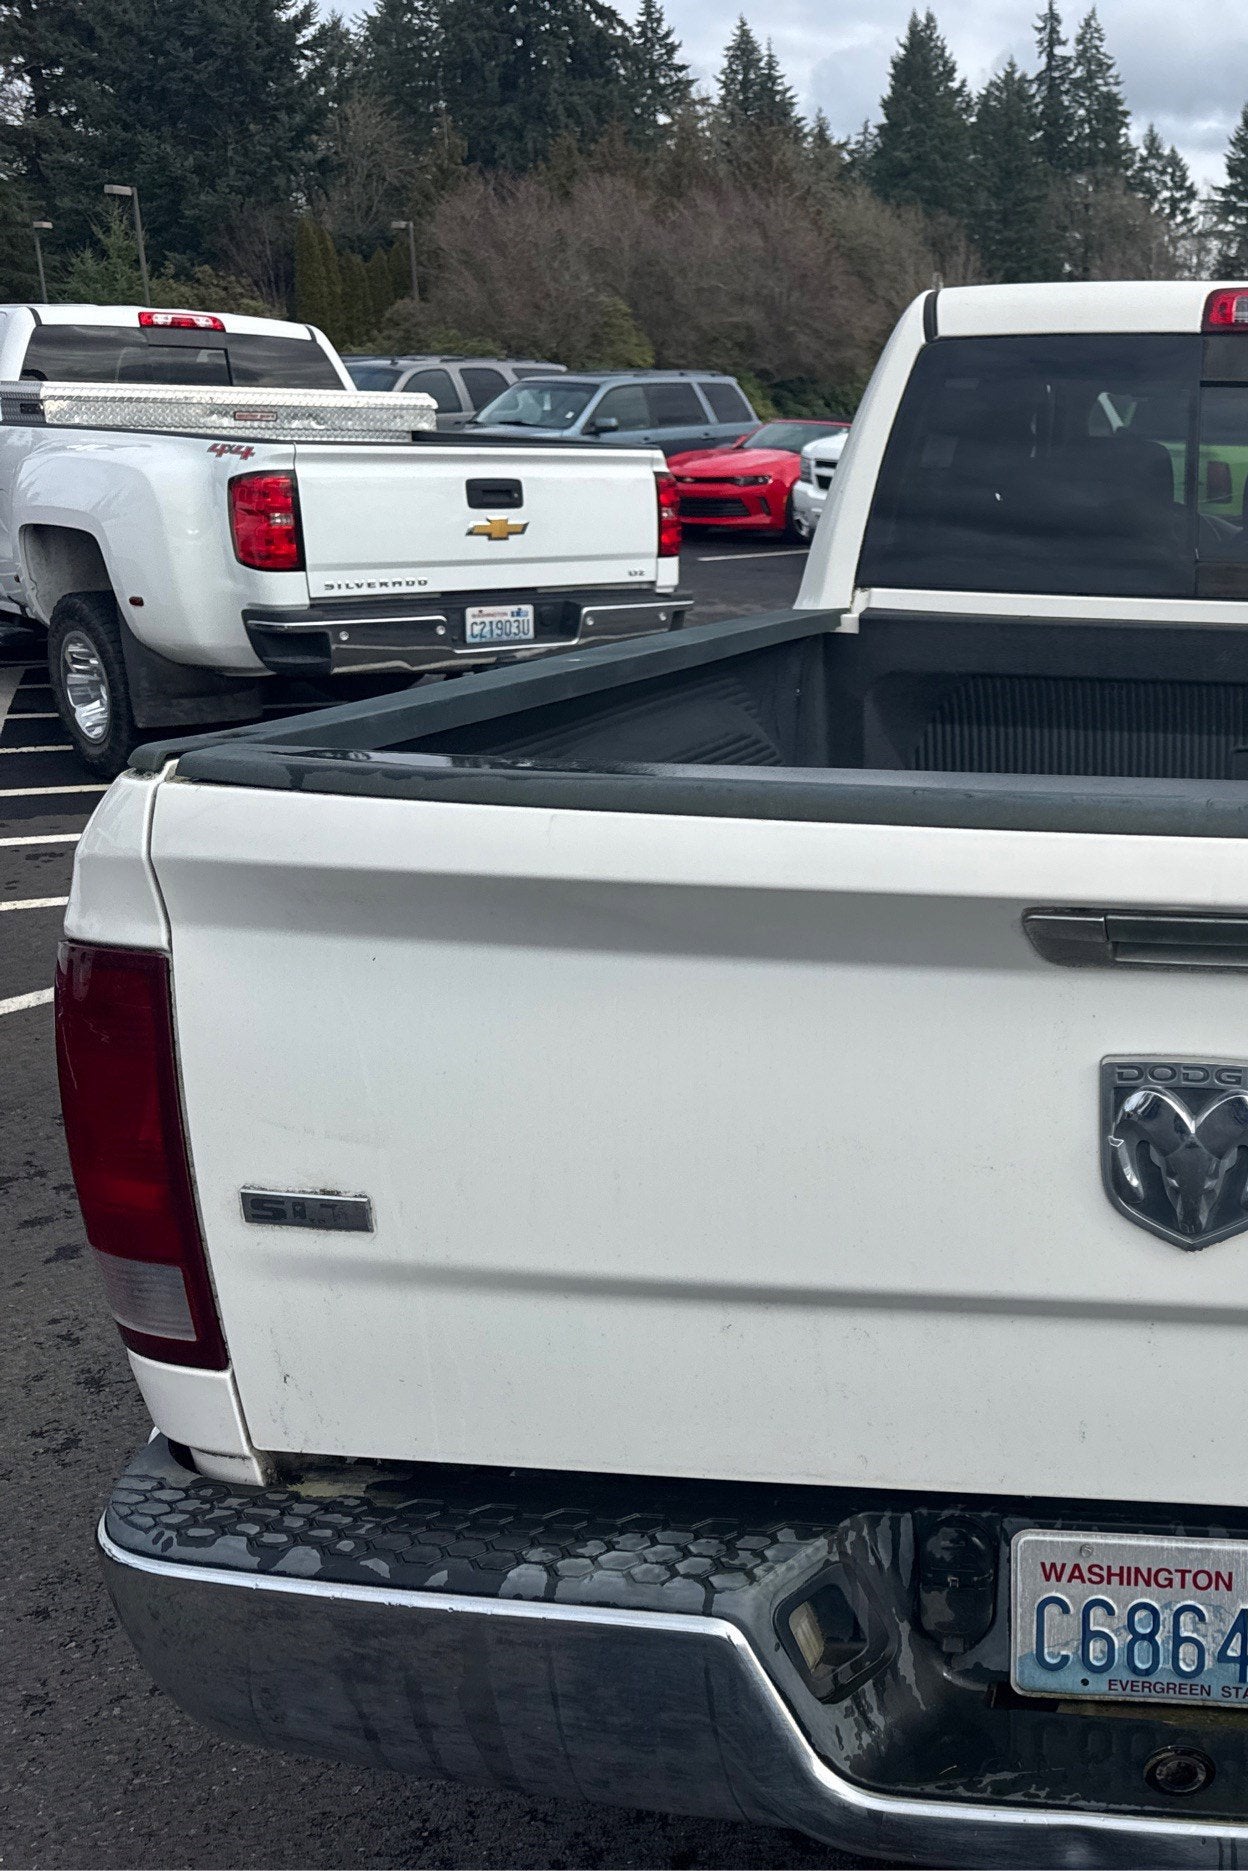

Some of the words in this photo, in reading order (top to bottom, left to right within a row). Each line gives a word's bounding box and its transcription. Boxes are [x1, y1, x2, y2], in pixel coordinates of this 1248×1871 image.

[324, 579, 429, 591] SILVERADO
[470, 618, 530, 639] C21903U
[1040, 1561, 1234, 1592] WASHINGTON
[1108, 1678, 1212, 1697] EVERGREEN
